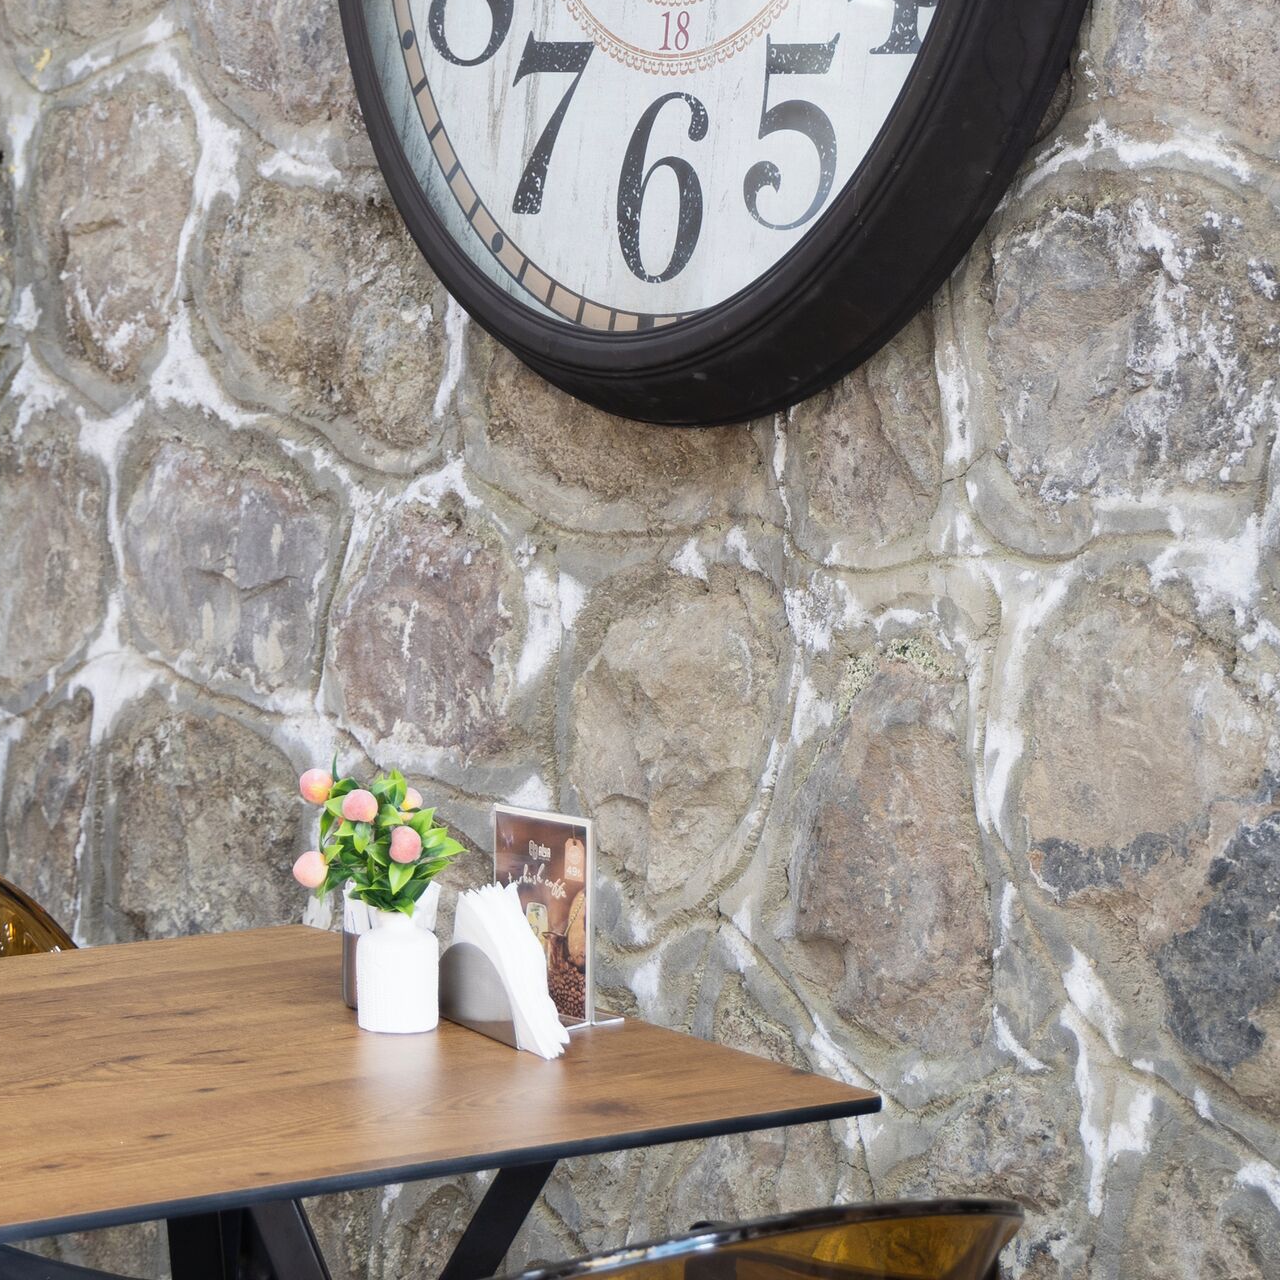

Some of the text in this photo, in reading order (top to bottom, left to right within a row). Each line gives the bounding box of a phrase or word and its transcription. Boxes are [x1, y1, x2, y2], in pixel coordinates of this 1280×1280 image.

[511, 30, 595, 215] 7
[659, 10, 691, 52] 18
[617, 91, 708, 283] 6
[743, 32, 840, 231] 5
